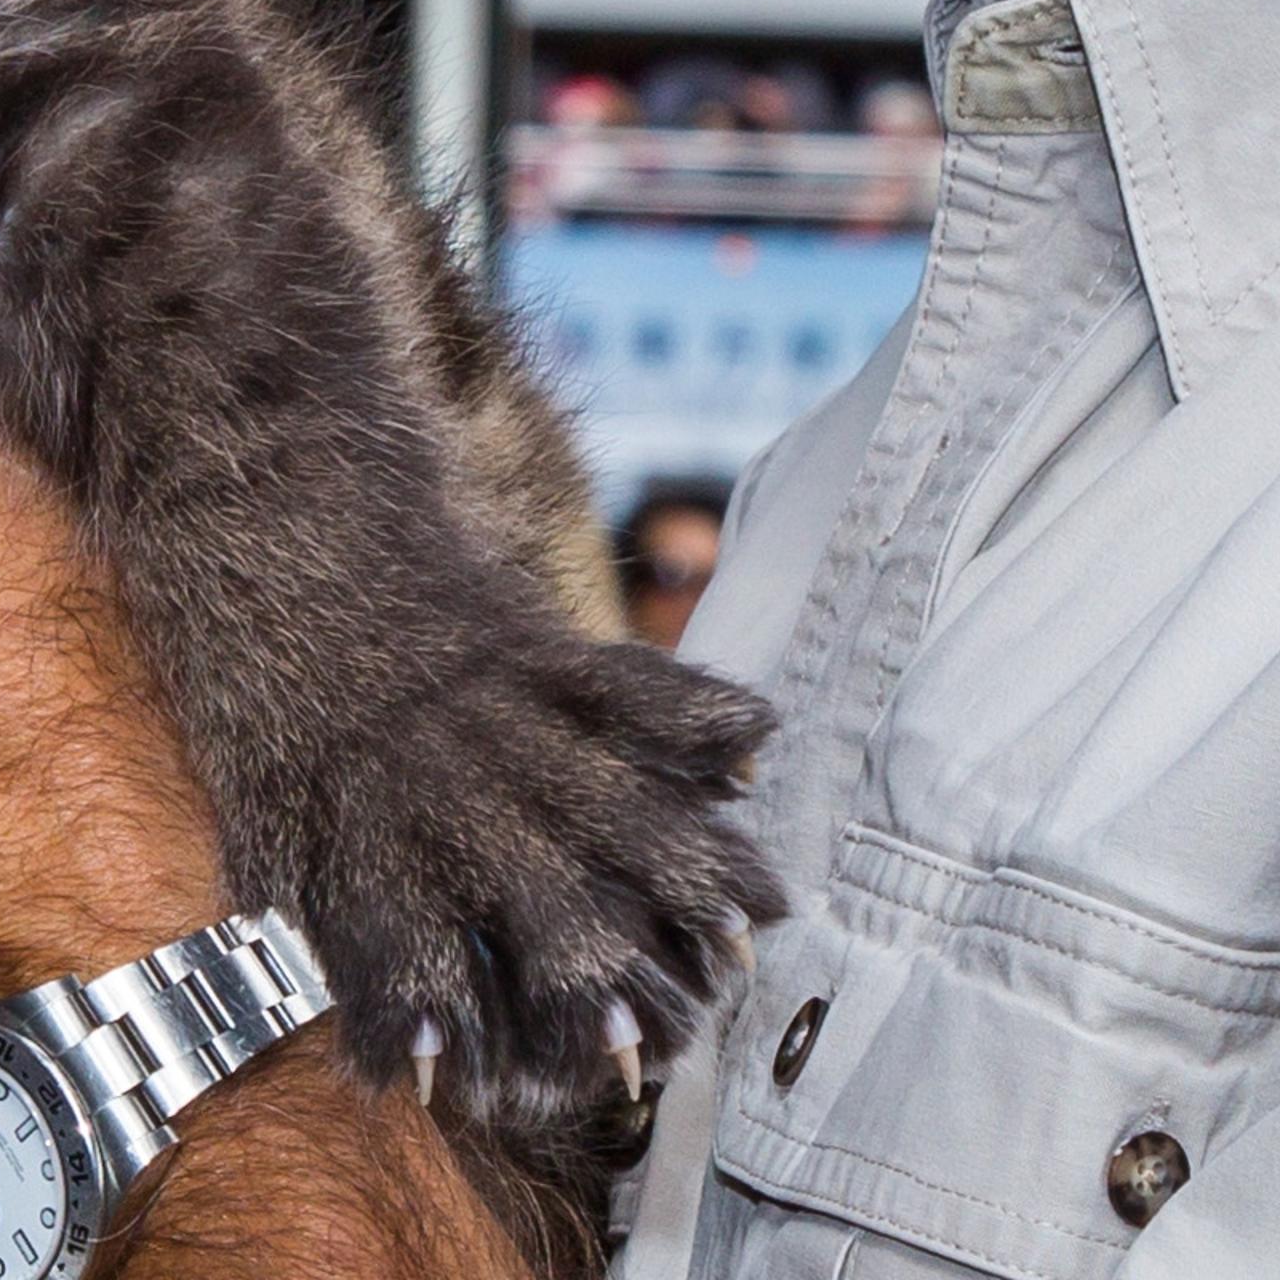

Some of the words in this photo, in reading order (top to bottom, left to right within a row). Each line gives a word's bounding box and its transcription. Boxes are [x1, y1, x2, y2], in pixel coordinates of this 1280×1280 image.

[38, 1083, 63, 1115] 12
[68, 1151, 89, 1187] 14
[68, 1223, 90, 1257] 16
